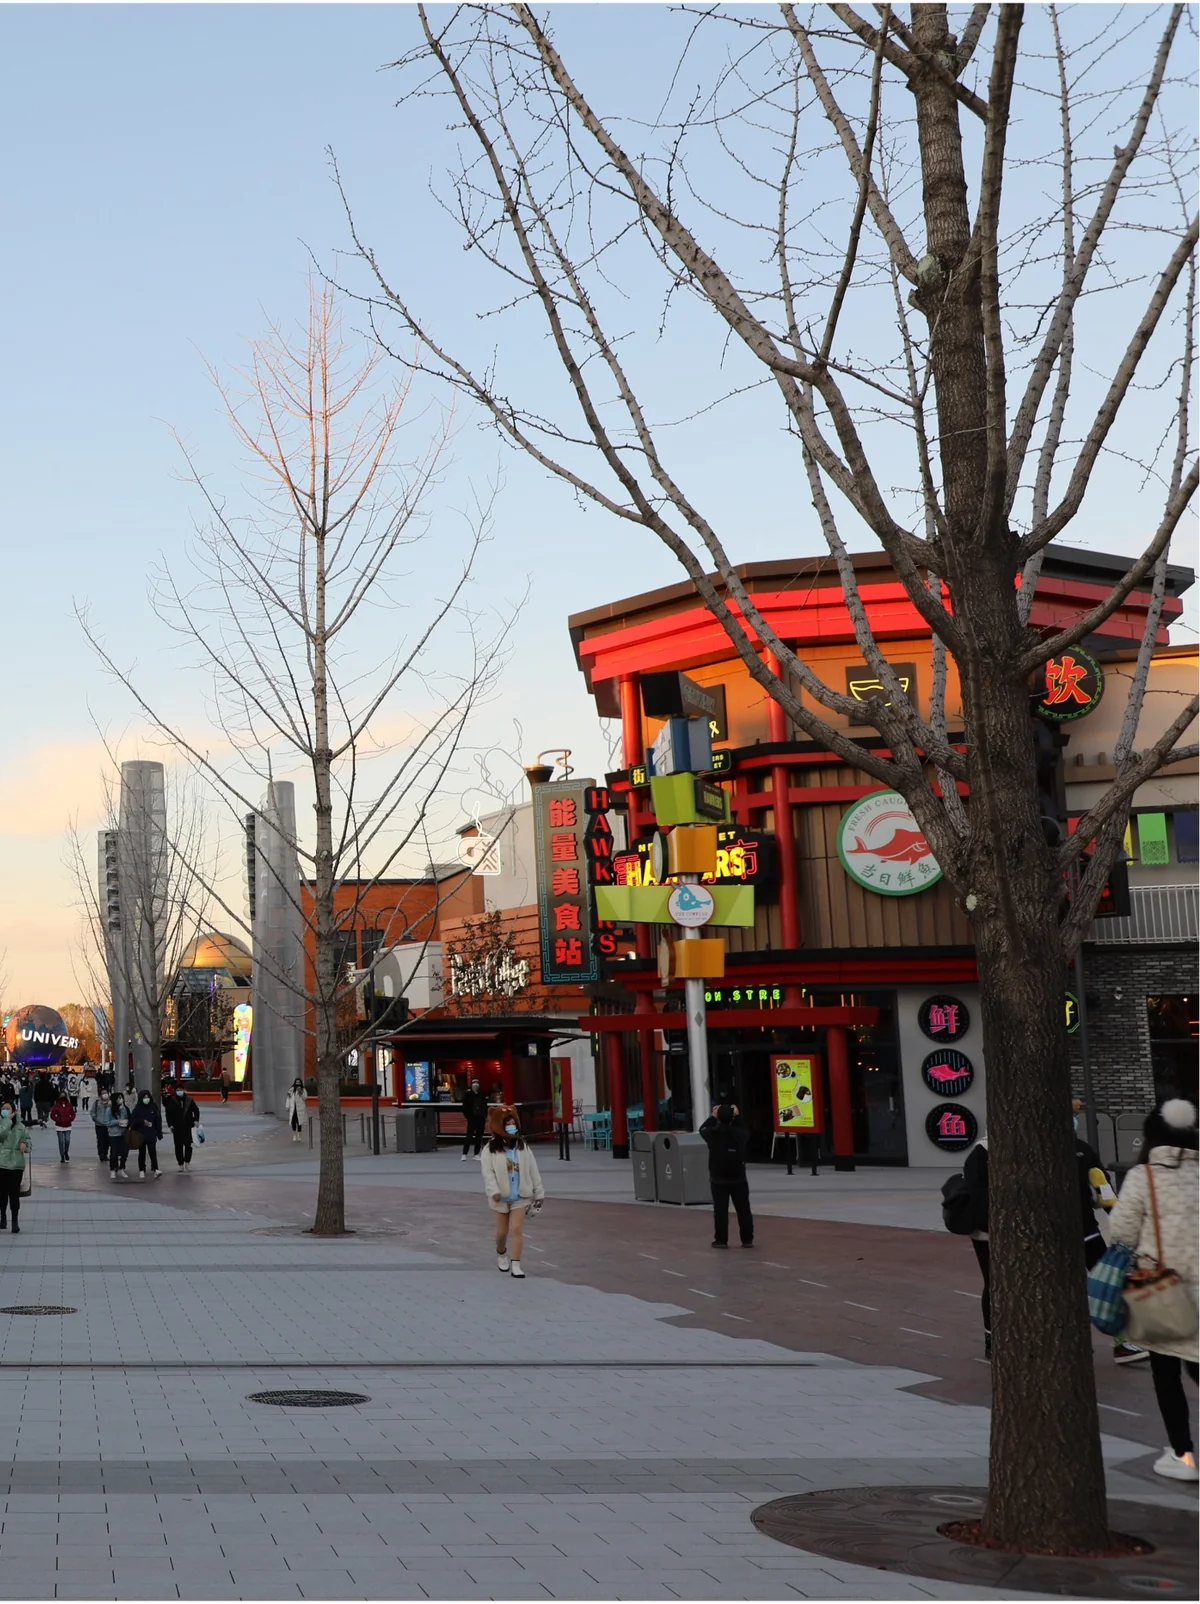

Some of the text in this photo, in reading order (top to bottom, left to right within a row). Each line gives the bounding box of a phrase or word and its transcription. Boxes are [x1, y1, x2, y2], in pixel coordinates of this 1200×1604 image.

[847, 805, 872, 832] FRESH
[548, 798, 583, 966] 能量美食站
